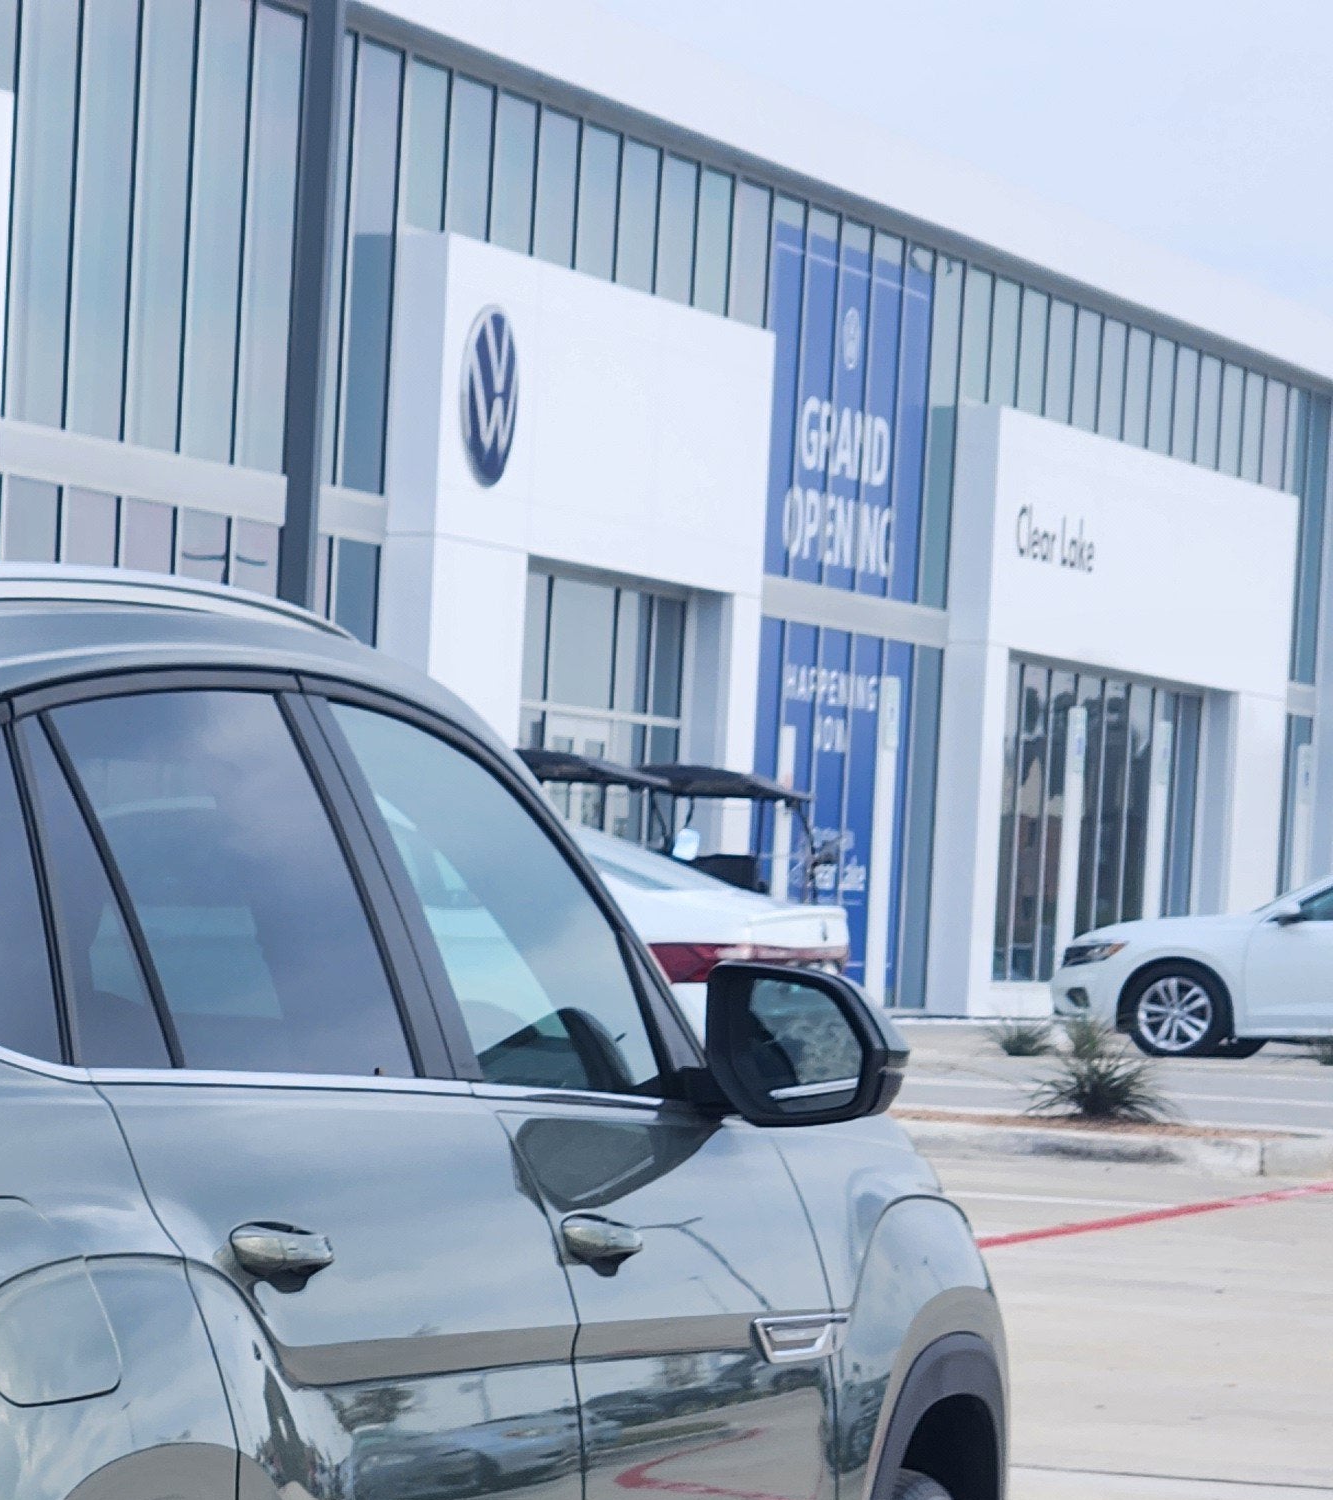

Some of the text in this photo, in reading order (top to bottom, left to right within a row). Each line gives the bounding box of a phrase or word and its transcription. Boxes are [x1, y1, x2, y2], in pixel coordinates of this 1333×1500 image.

[800, 395, 891, 488] GRAND
[784, 485, 896, 579] OPENING
[1016, 502, 1094, 575] Clear Lake
